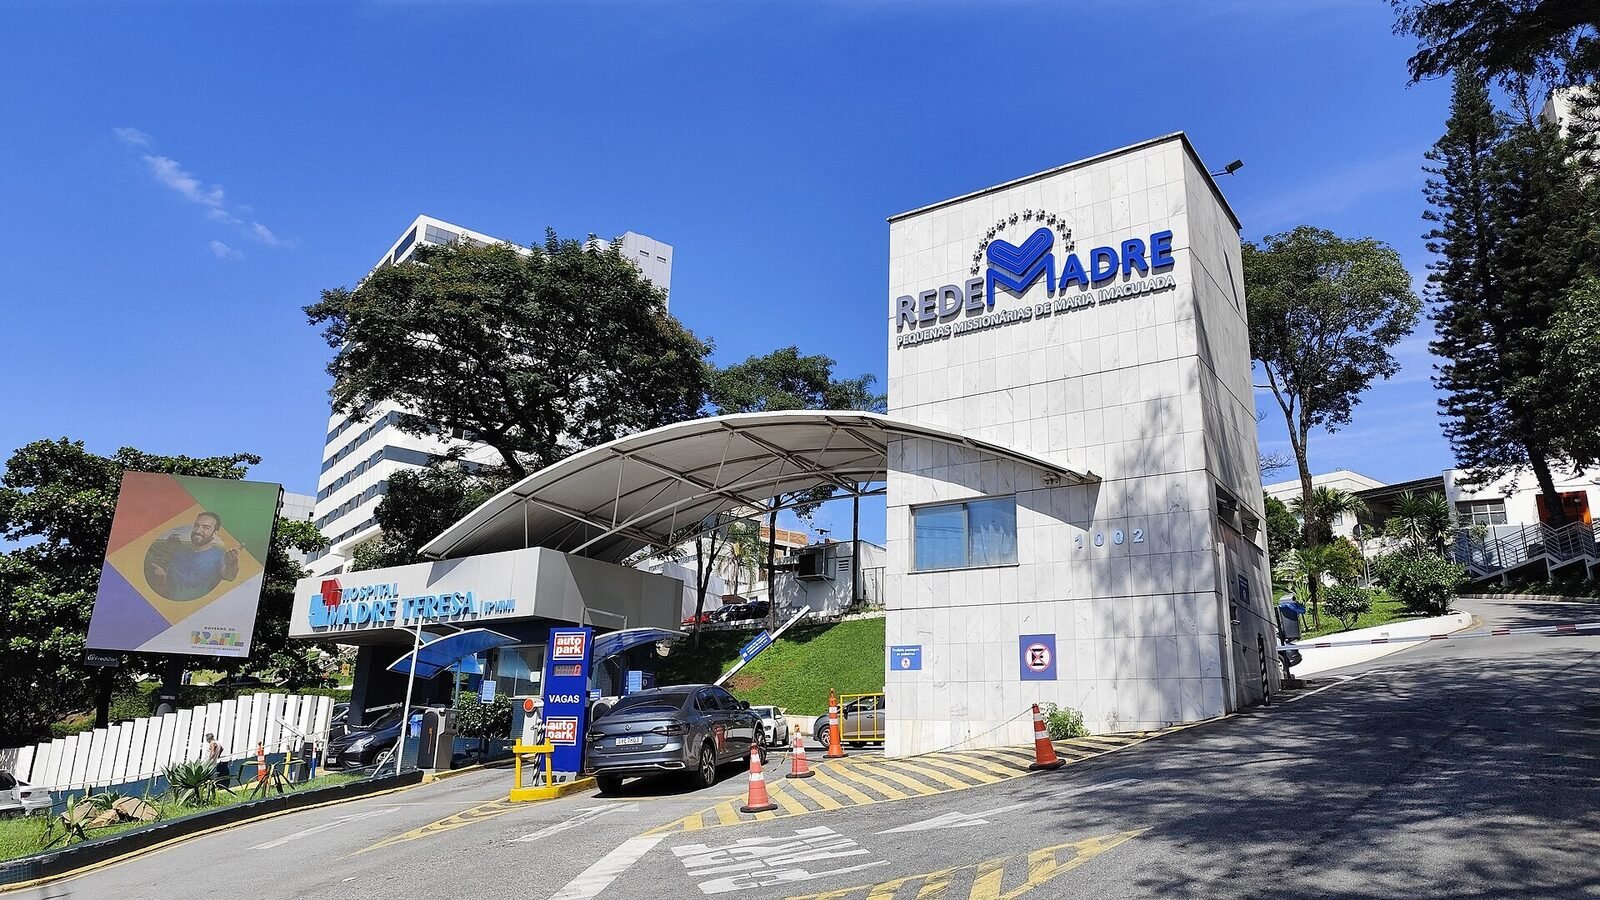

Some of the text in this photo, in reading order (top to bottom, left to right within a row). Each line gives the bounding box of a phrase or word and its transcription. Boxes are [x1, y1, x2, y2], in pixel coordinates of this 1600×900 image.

[895, 227, 1175, 331] REDE MADRE
[896, 275, 1176, 349] PEQUENAS MISSIONÁRIAS DE MARIA IMACULADA
[1074, 528, 1145, 548] 1002
[342, 583, 399, 602] HOSPITAL
[326, 599, 398, 628] MADRE
[401, 591, 478, 623] TERESA
[556, 635, 581, 646] auto
[555, 645, 581, 656] park
[548, 694, 580, 704] VAGAS
[547, 720, 574, 731] auto
[547, 730, 574, 741] park
